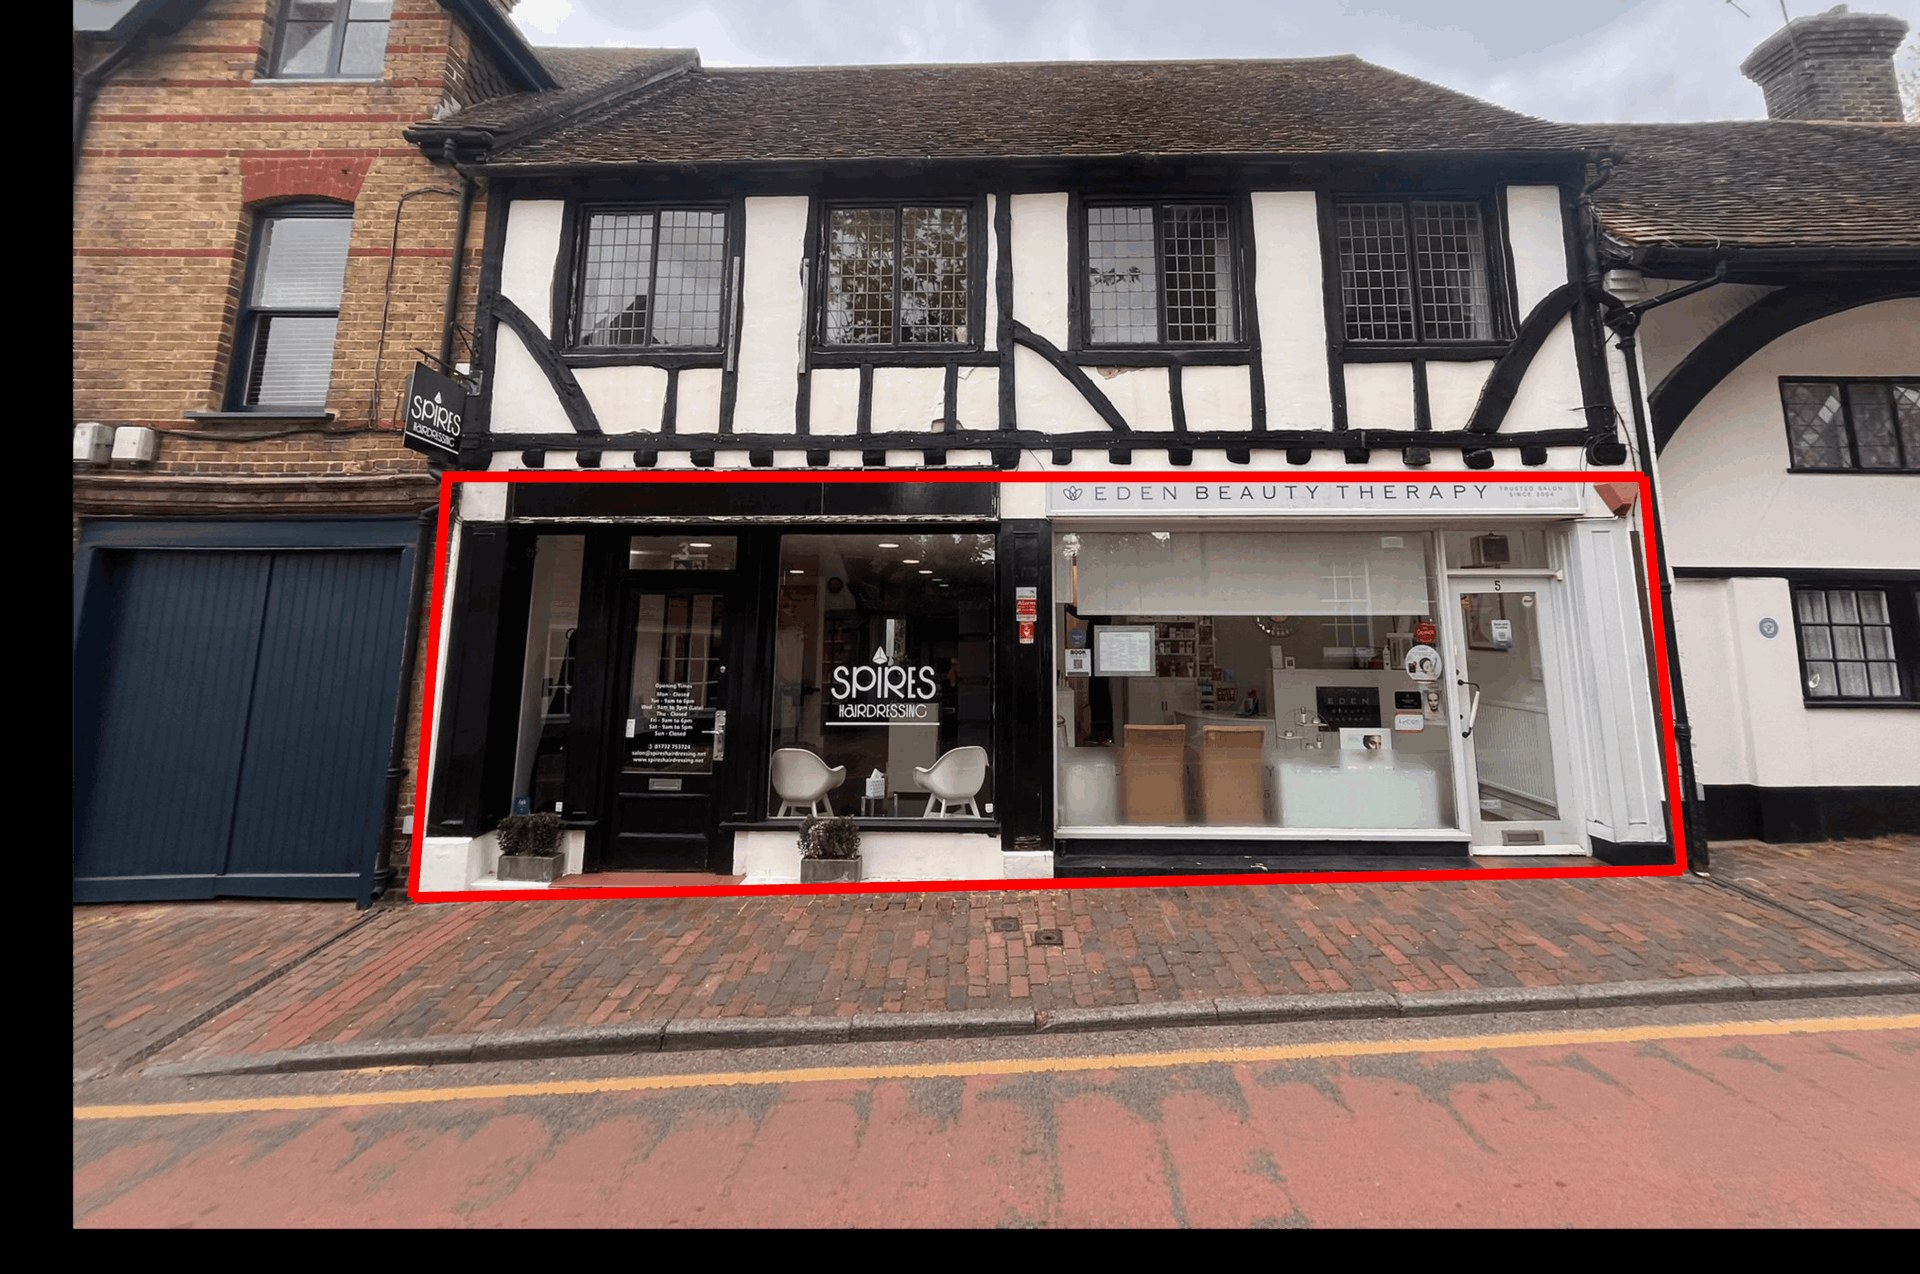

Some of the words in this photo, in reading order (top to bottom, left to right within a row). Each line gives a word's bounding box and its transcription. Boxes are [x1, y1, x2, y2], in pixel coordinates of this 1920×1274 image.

[411, 395, 461, 436] SPIRES
[1094, 486, 1177, 500] EDEN
[1195, 486, 1319, 500] BEAUTY
[1336, 485, 1487, 499] THERAPY
[680, 542, 689, 560] 3
[1495, 580, 1501, 591] 5
[831, 666, 937, 699] SPIRES
[1327, 697, 1369, 705] EDEN
